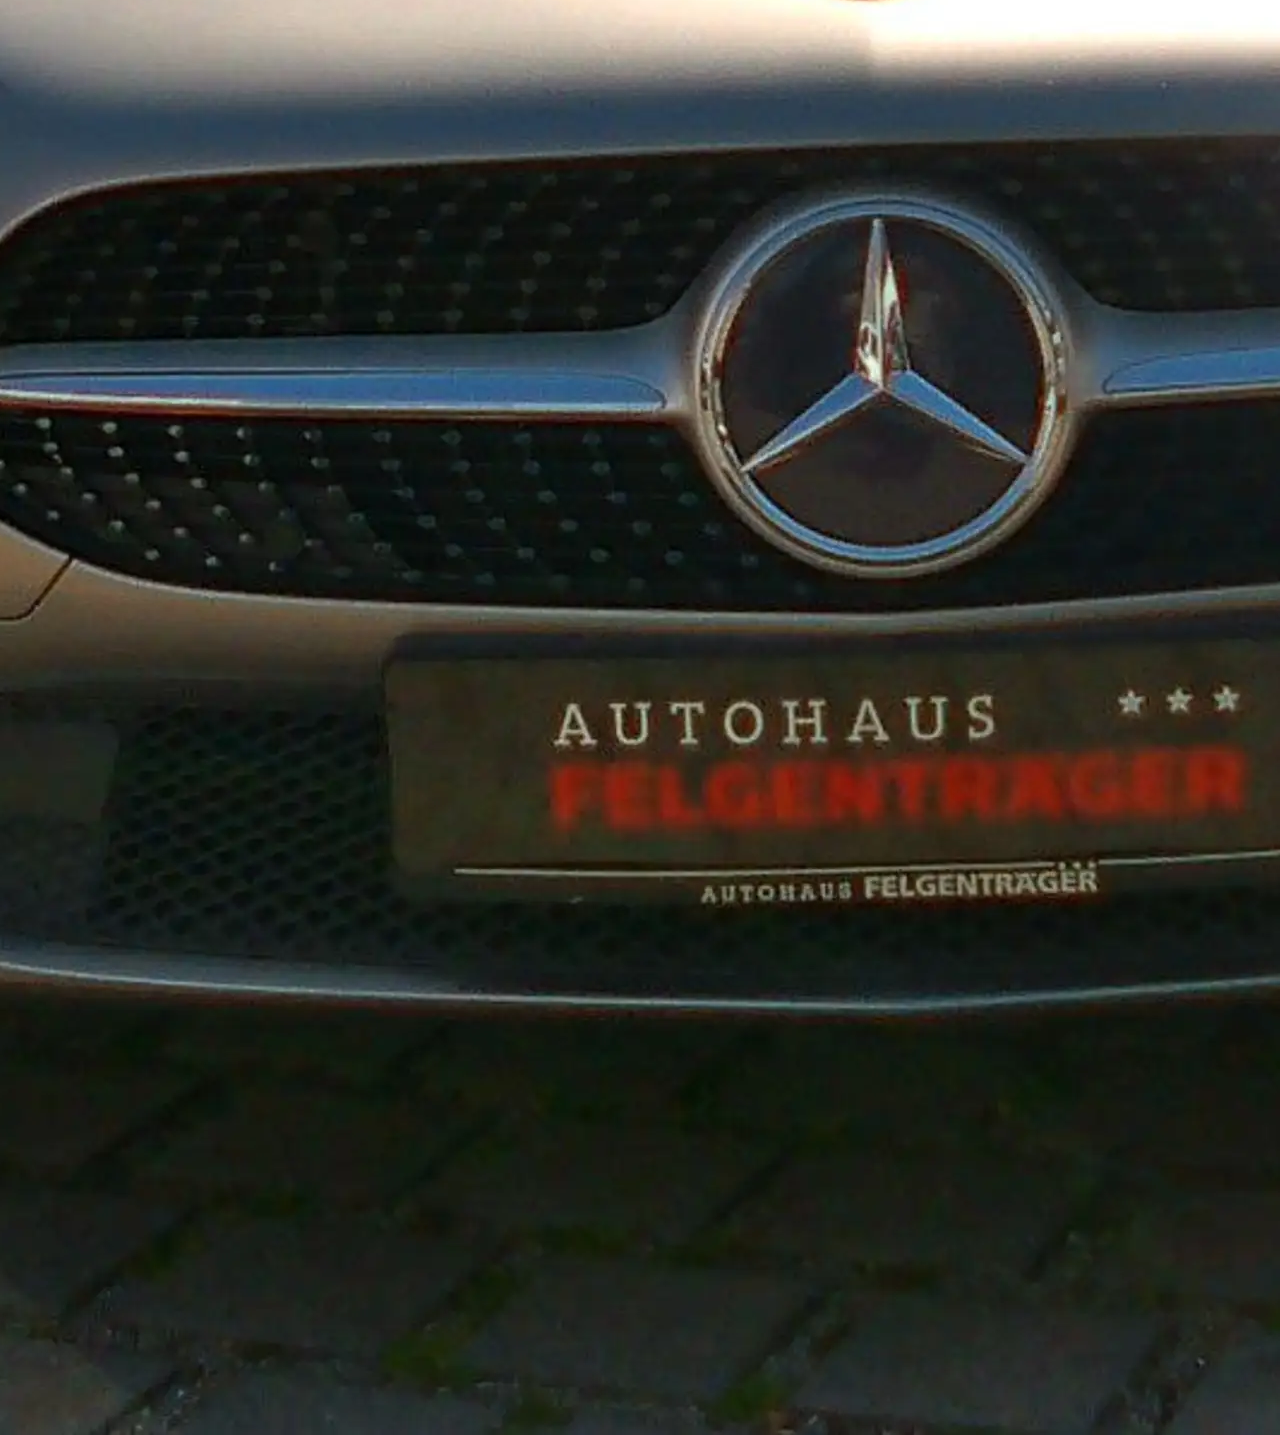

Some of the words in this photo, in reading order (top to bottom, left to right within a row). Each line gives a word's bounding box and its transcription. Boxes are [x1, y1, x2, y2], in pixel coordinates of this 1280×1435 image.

[552, 694, 997, 747] AUTOHAUS
[700, 880, 853, 905] AUTOHAUS
[863, 869, 1098, 900] FELGENTRÄGER
